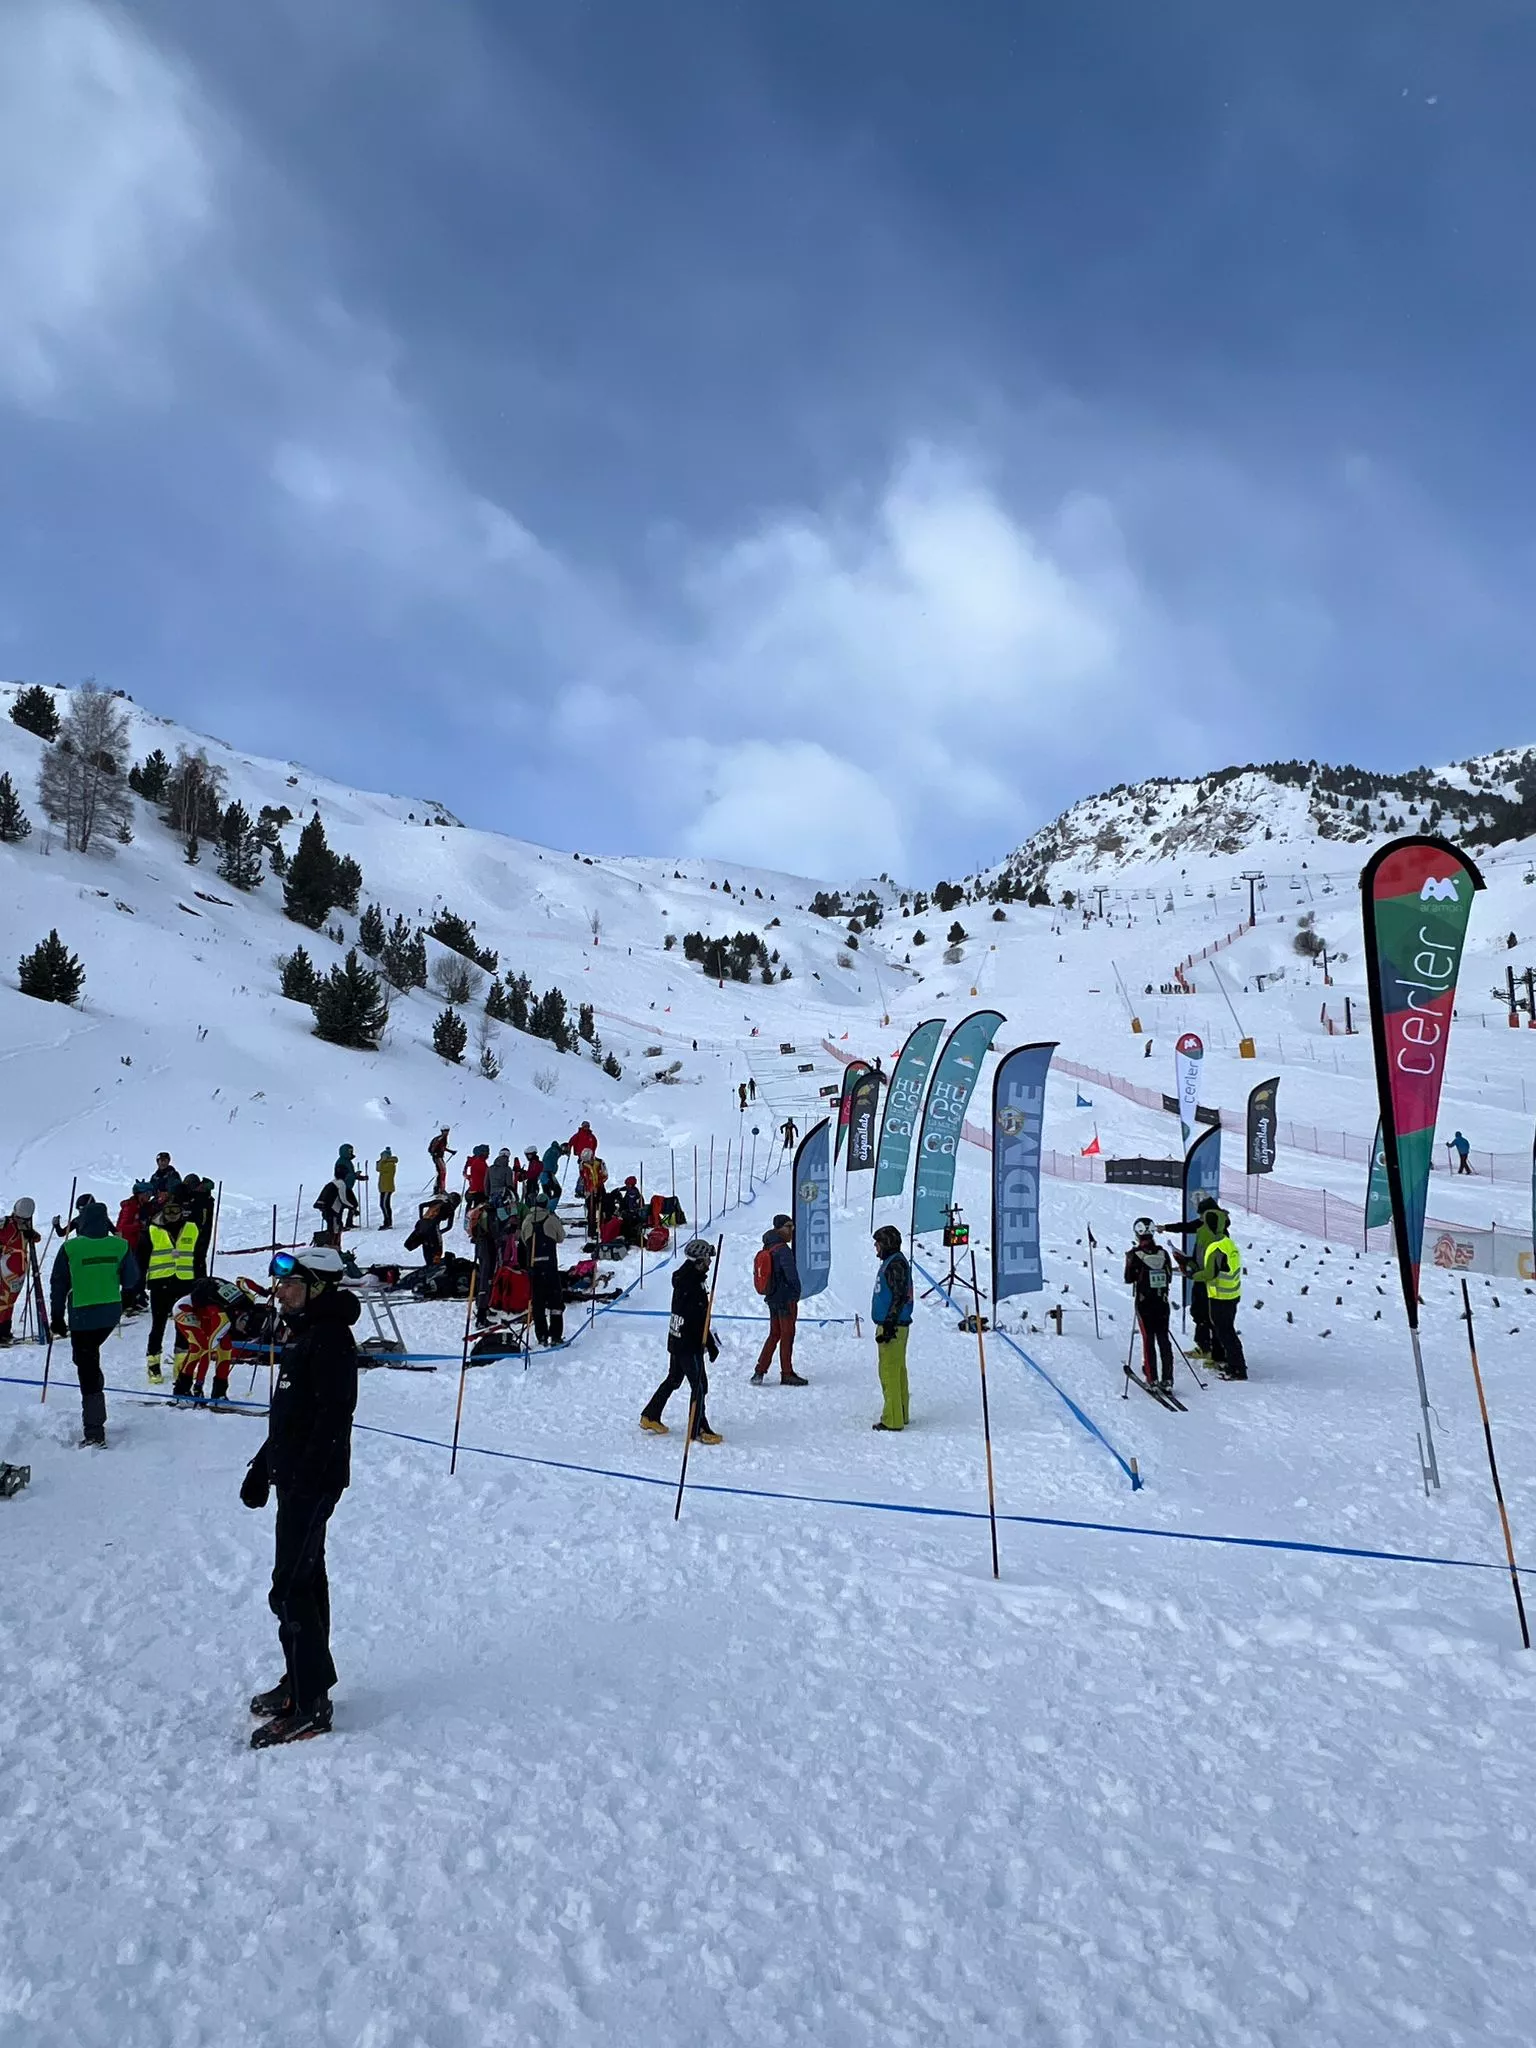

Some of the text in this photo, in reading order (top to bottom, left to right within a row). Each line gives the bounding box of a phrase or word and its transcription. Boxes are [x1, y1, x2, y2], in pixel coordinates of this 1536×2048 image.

[1395, 926, 1456, 1075] cerler
[1184, 1061, 1199, 1104] cerler
[810, 1162, 830, 1270] FEDME
[1003, 1082, 1042, 1275] FEDME
